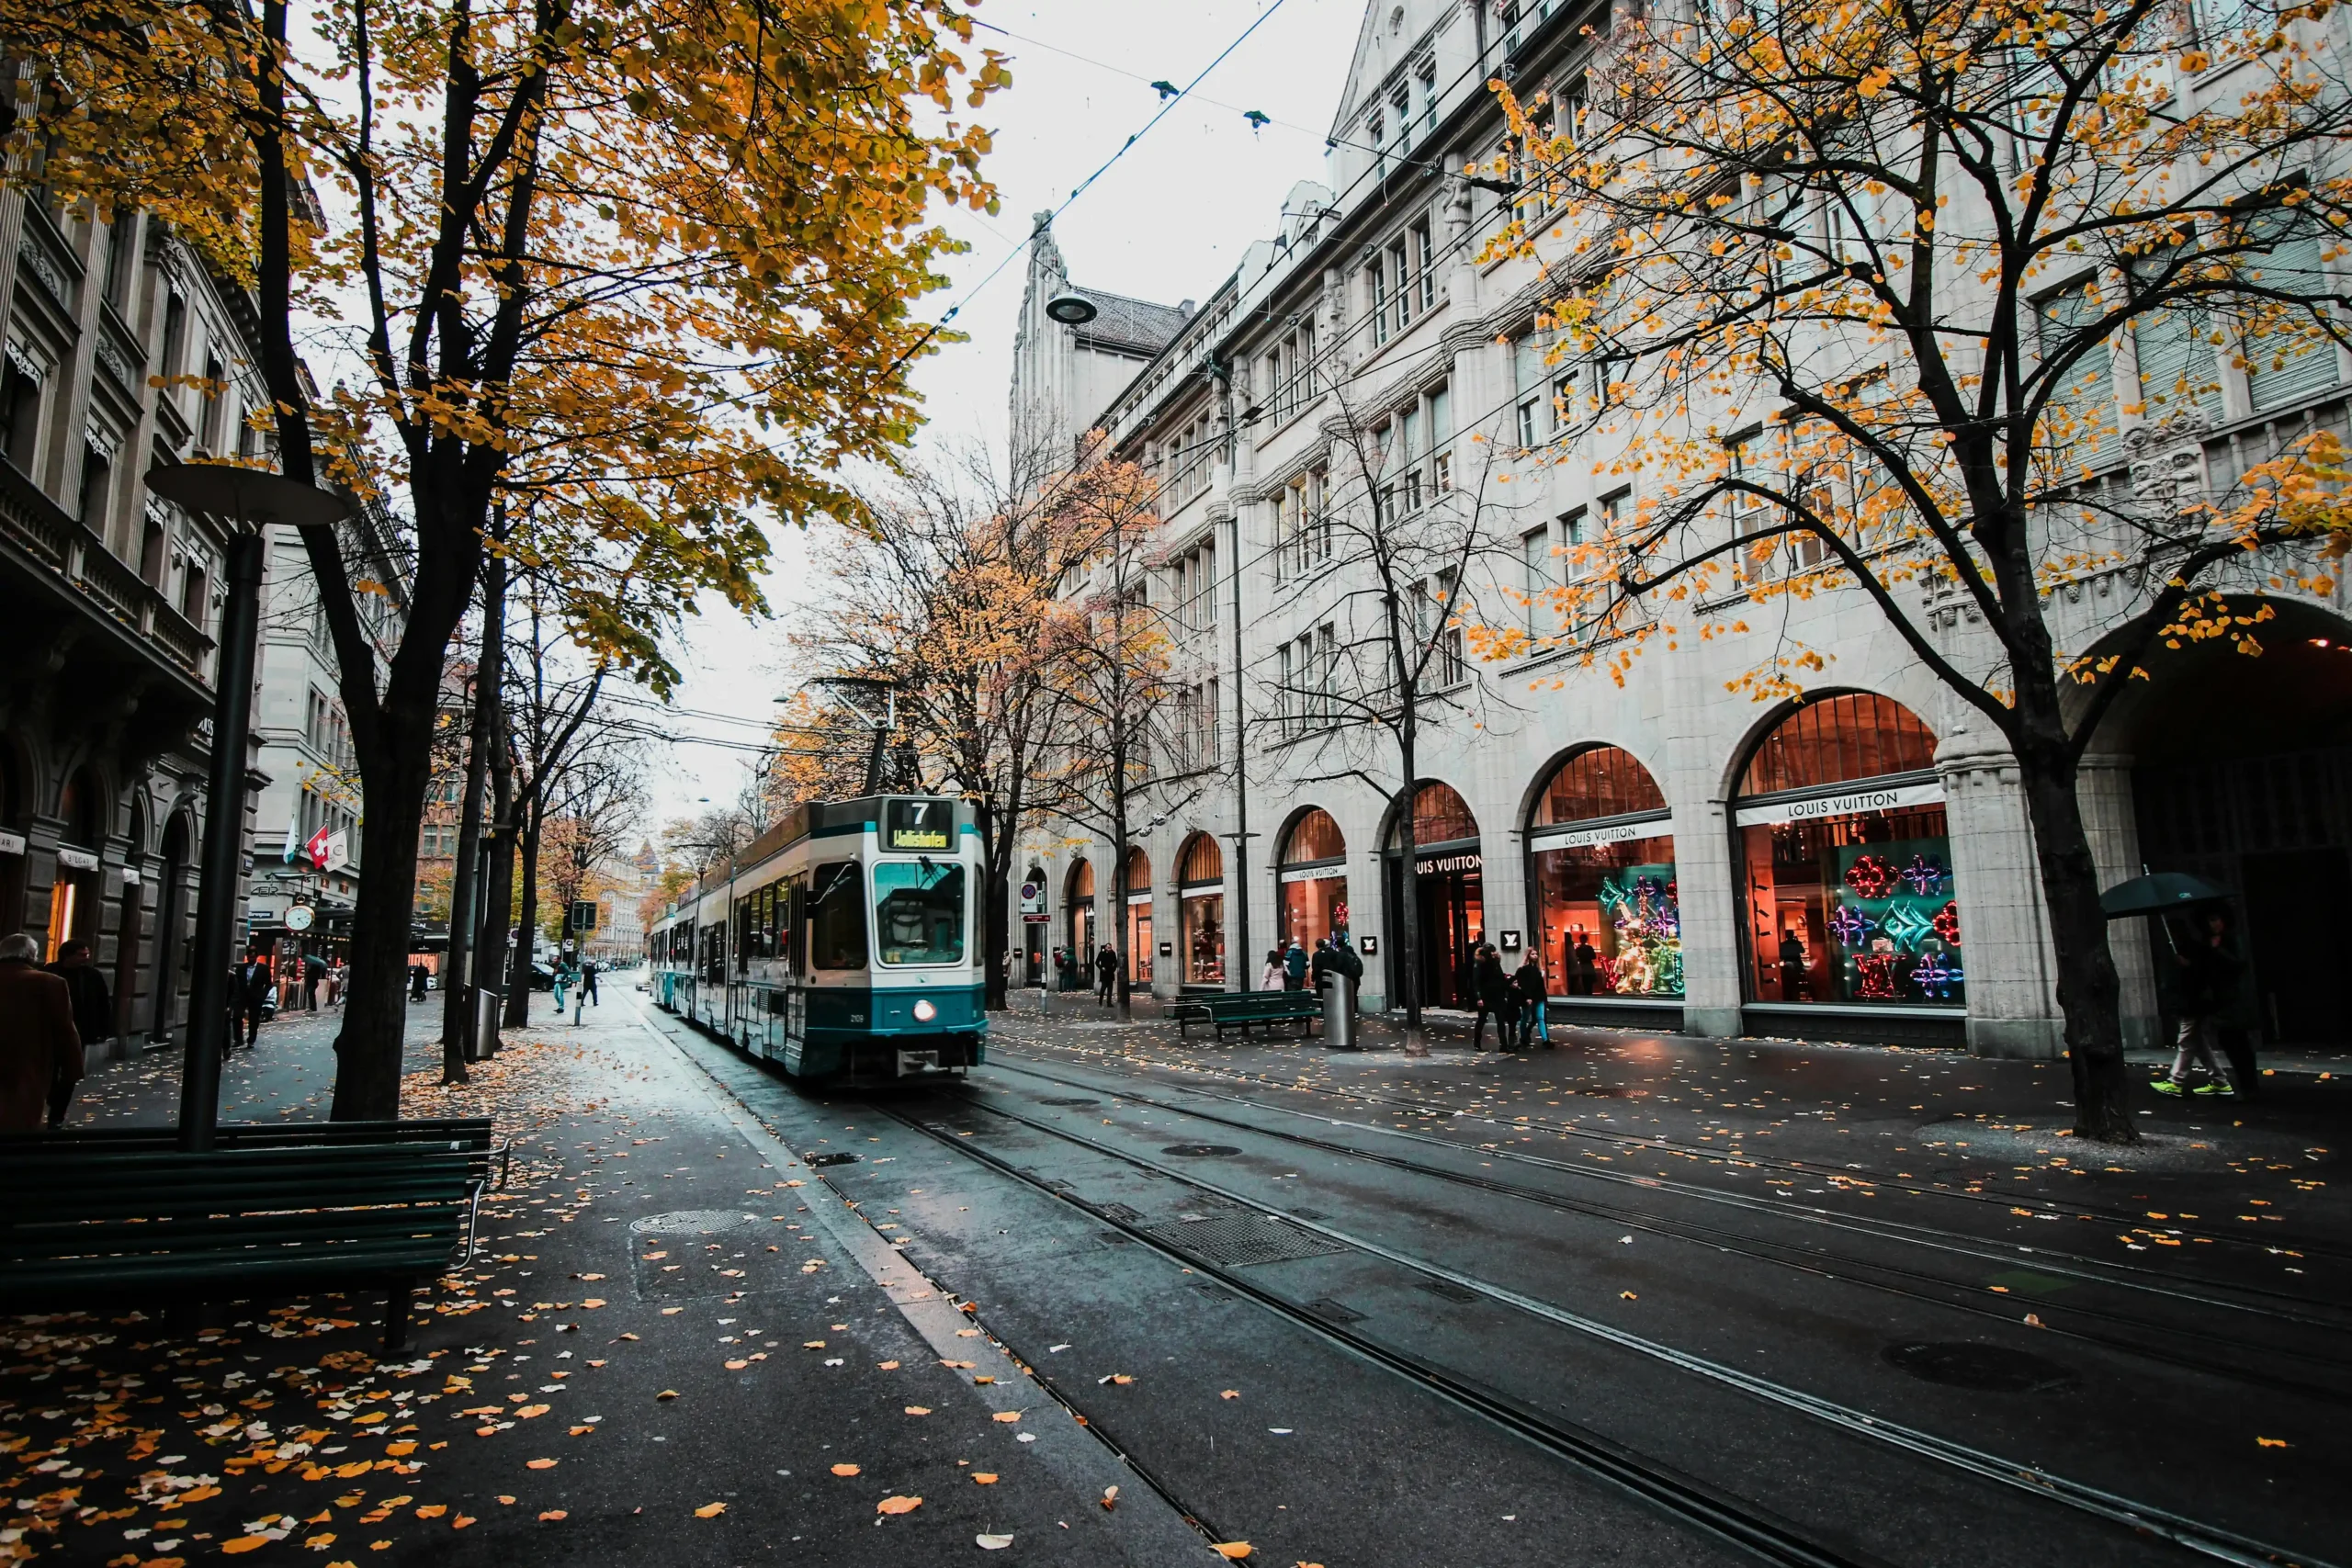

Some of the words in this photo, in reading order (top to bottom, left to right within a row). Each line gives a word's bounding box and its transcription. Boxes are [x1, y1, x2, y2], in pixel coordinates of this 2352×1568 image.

[911, 802, 929, 825] 7
[1788, 801, 1828, 817] LOUIS
[1833, 792, 1897, 811] VUITTON
[0, 838, 14, 848] ARI
[1565, 832, 1591, 845] LOUIS
[1595, 827, 1635, 840] VUITTON
[1315, 867, 1338, 876] VUITTON
[1415, 861, 1433, 874] UIS
[1436, 854, 1483, 873] VUITTON
